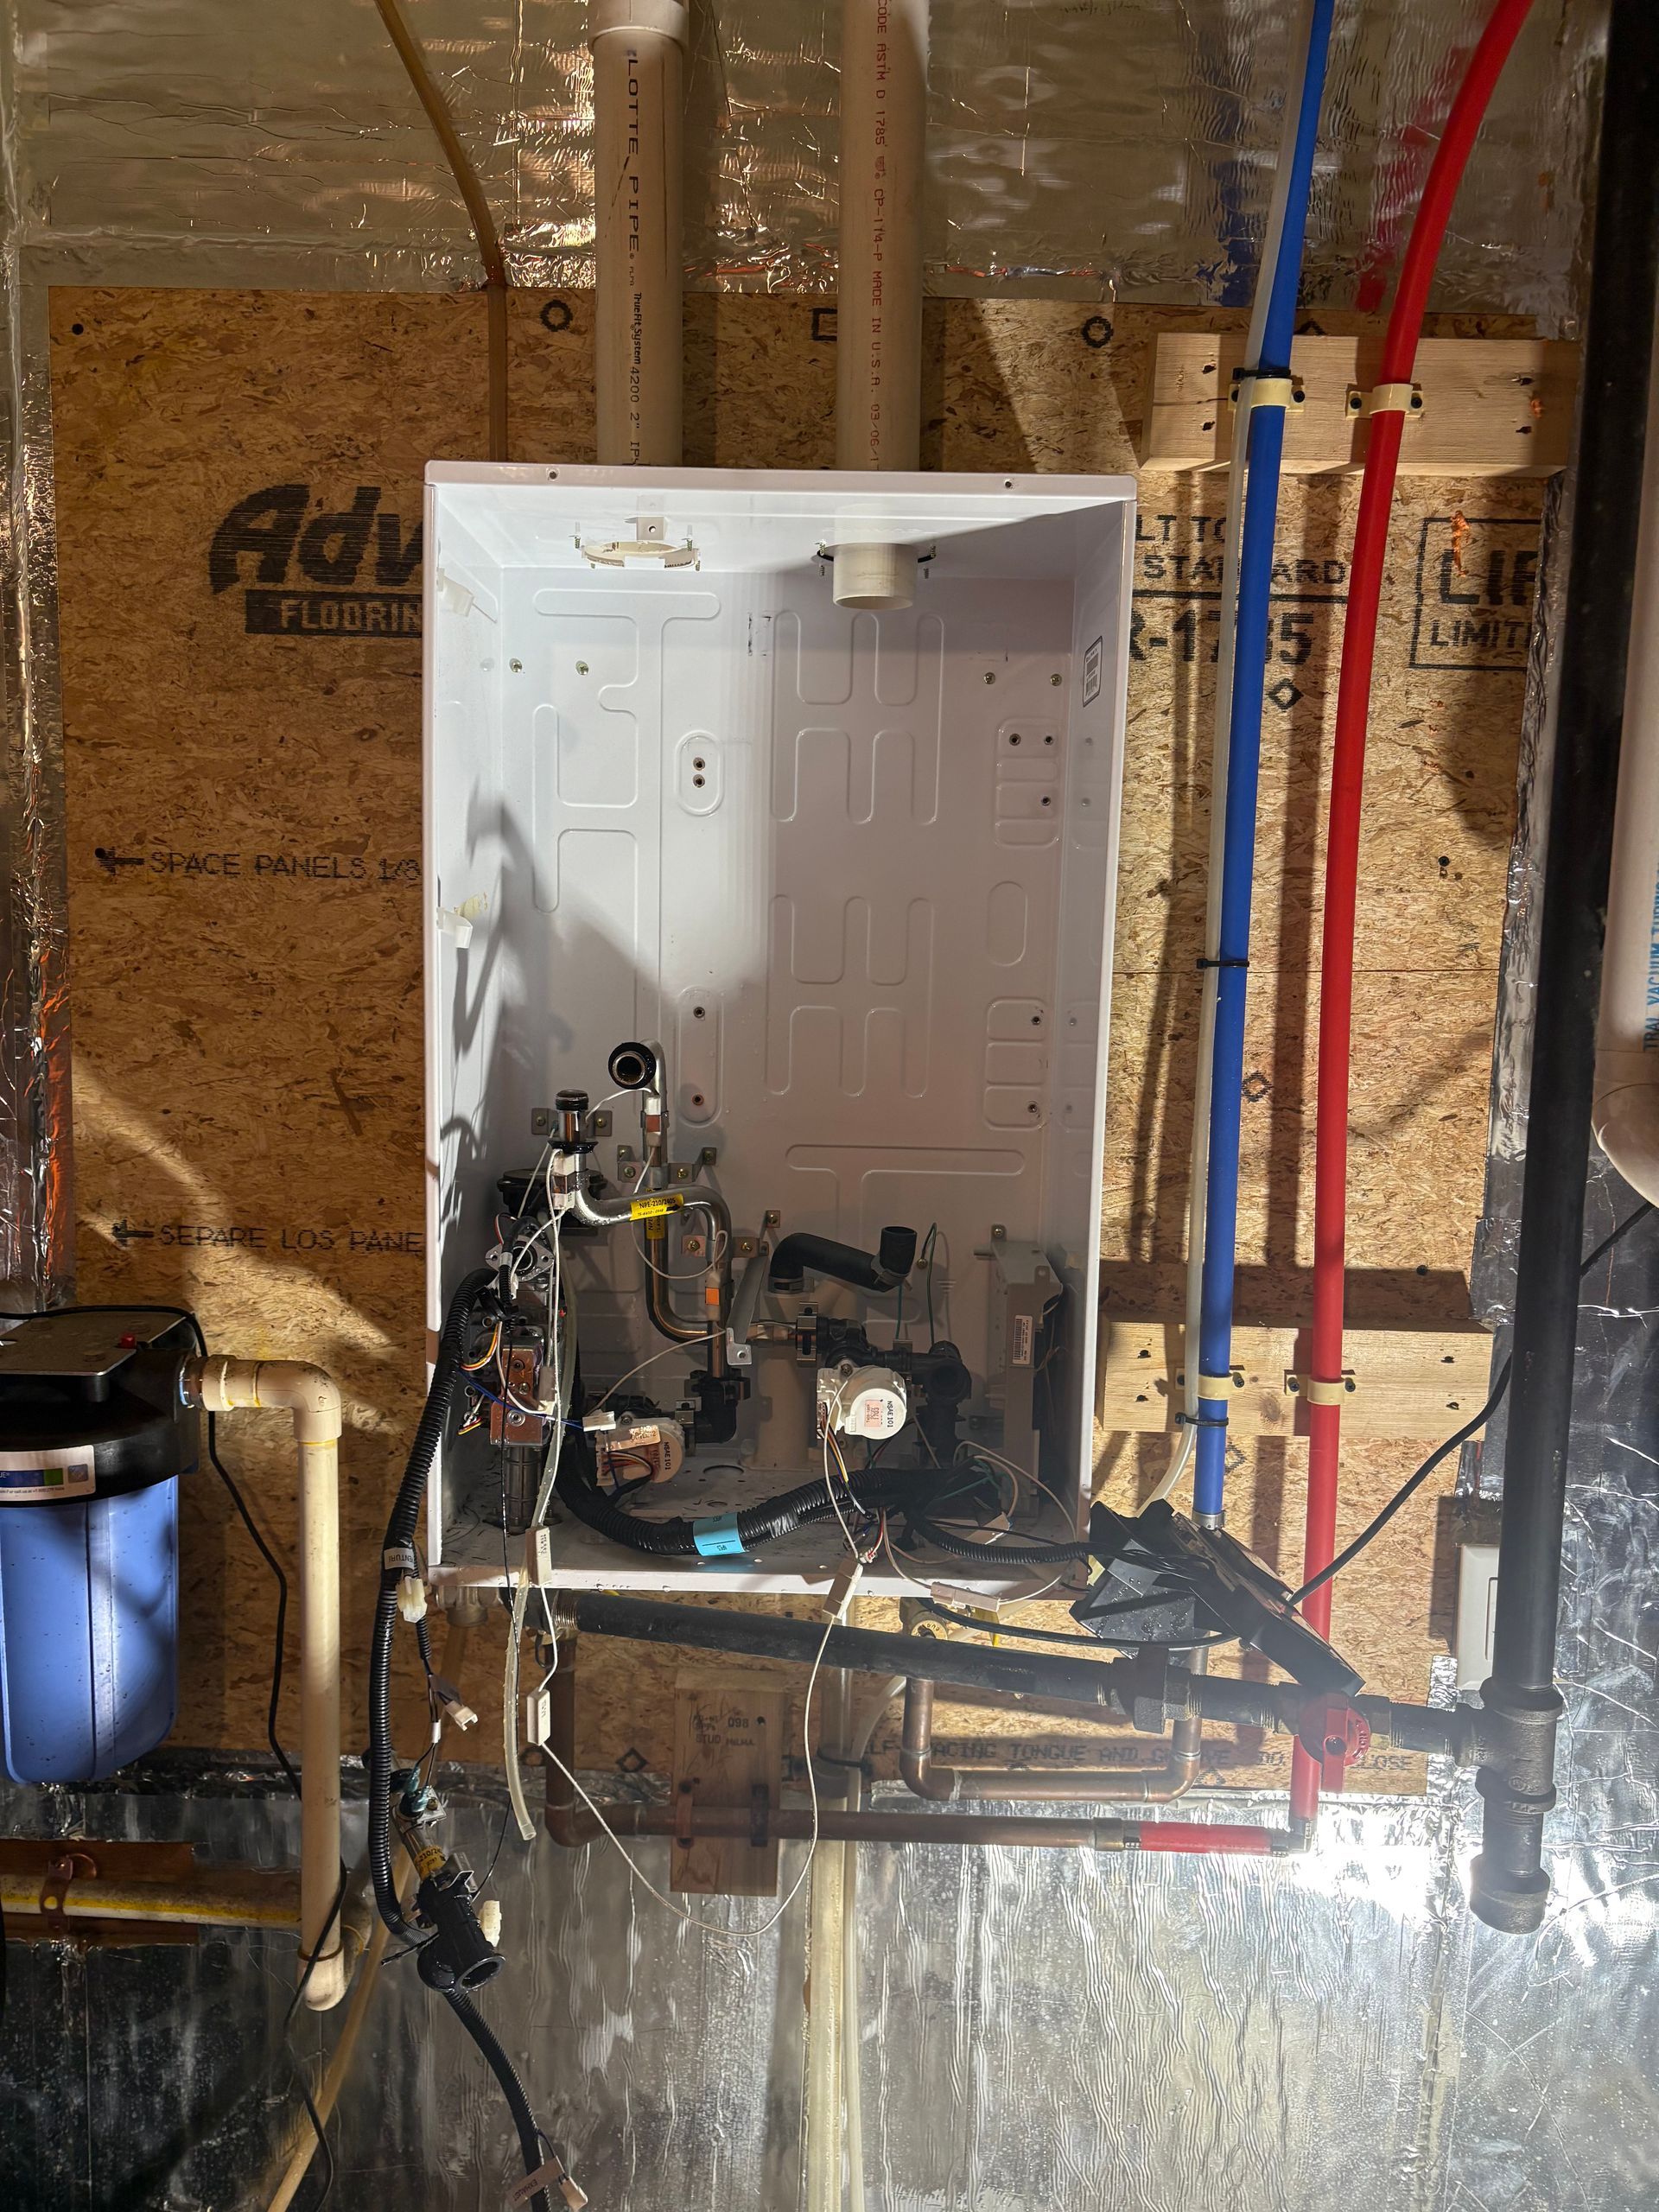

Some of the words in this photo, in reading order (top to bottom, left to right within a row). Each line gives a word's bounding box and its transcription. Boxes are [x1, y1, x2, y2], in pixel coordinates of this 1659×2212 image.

[876, 43, 887, 80] ASTM
[876, 90, 886, 99] D
[875, 111, 885, 145] 1785
[872, 270, 882, 307] MADE
[872, 317, 881, 333] IN
[871, 342, 881, 393] U.S.A.
[630, 366, 639, 404] 4200
[870, 404, 880, 471] 03/06/1
[1142, 555, 1346, 585] STAARD
[1430, 620, 1532, 647] LIMIT
[151, 850, 241, 876] SPACE
[255, 854, 369, 880] PANELS
[159, 1223, 268, 1249] SEPARE
[281, 1226, 336, 1250] LOS
[696, 1733, 721, 1744] STUD
[1009, 1742, 1087, 1763] TONGUE
[1099, 1745, 1140, 1763] AND
